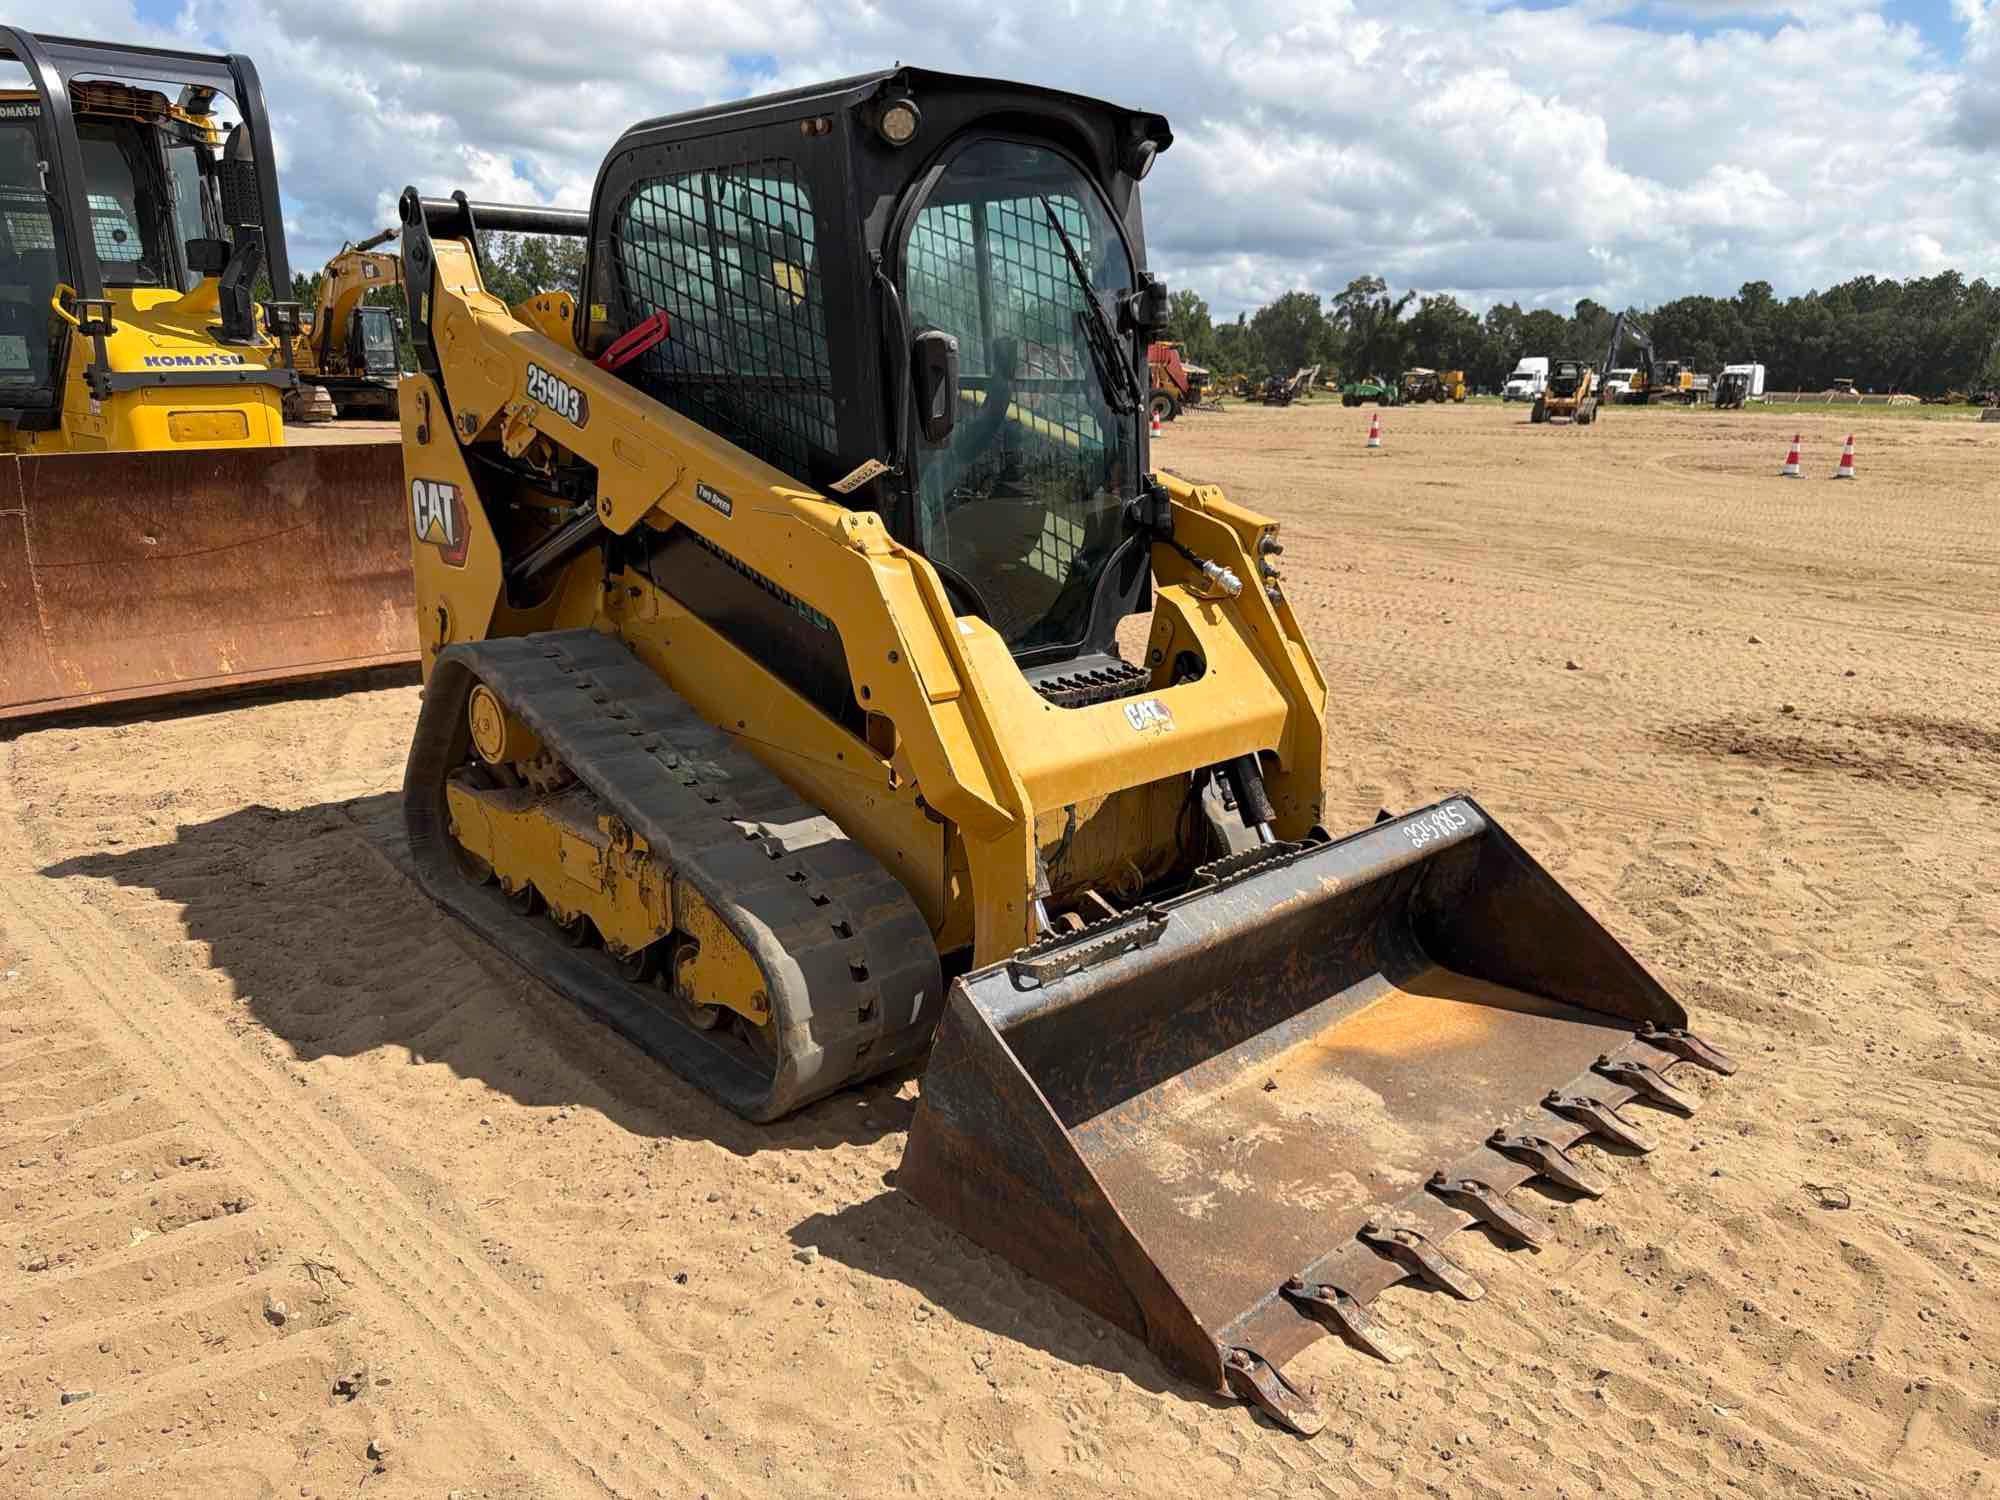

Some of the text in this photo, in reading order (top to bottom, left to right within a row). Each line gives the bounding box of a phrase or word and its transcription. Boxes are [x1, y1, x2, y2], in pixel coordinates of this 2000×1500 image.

[0, 104, 41, 118] OMATSU
[143, 353, 245, 367] KOMATSU
[527, 363, 580, 422] 259D3
[412, 479, 455, 547] CAT
[1122, 700, 1168, 731] CAT
